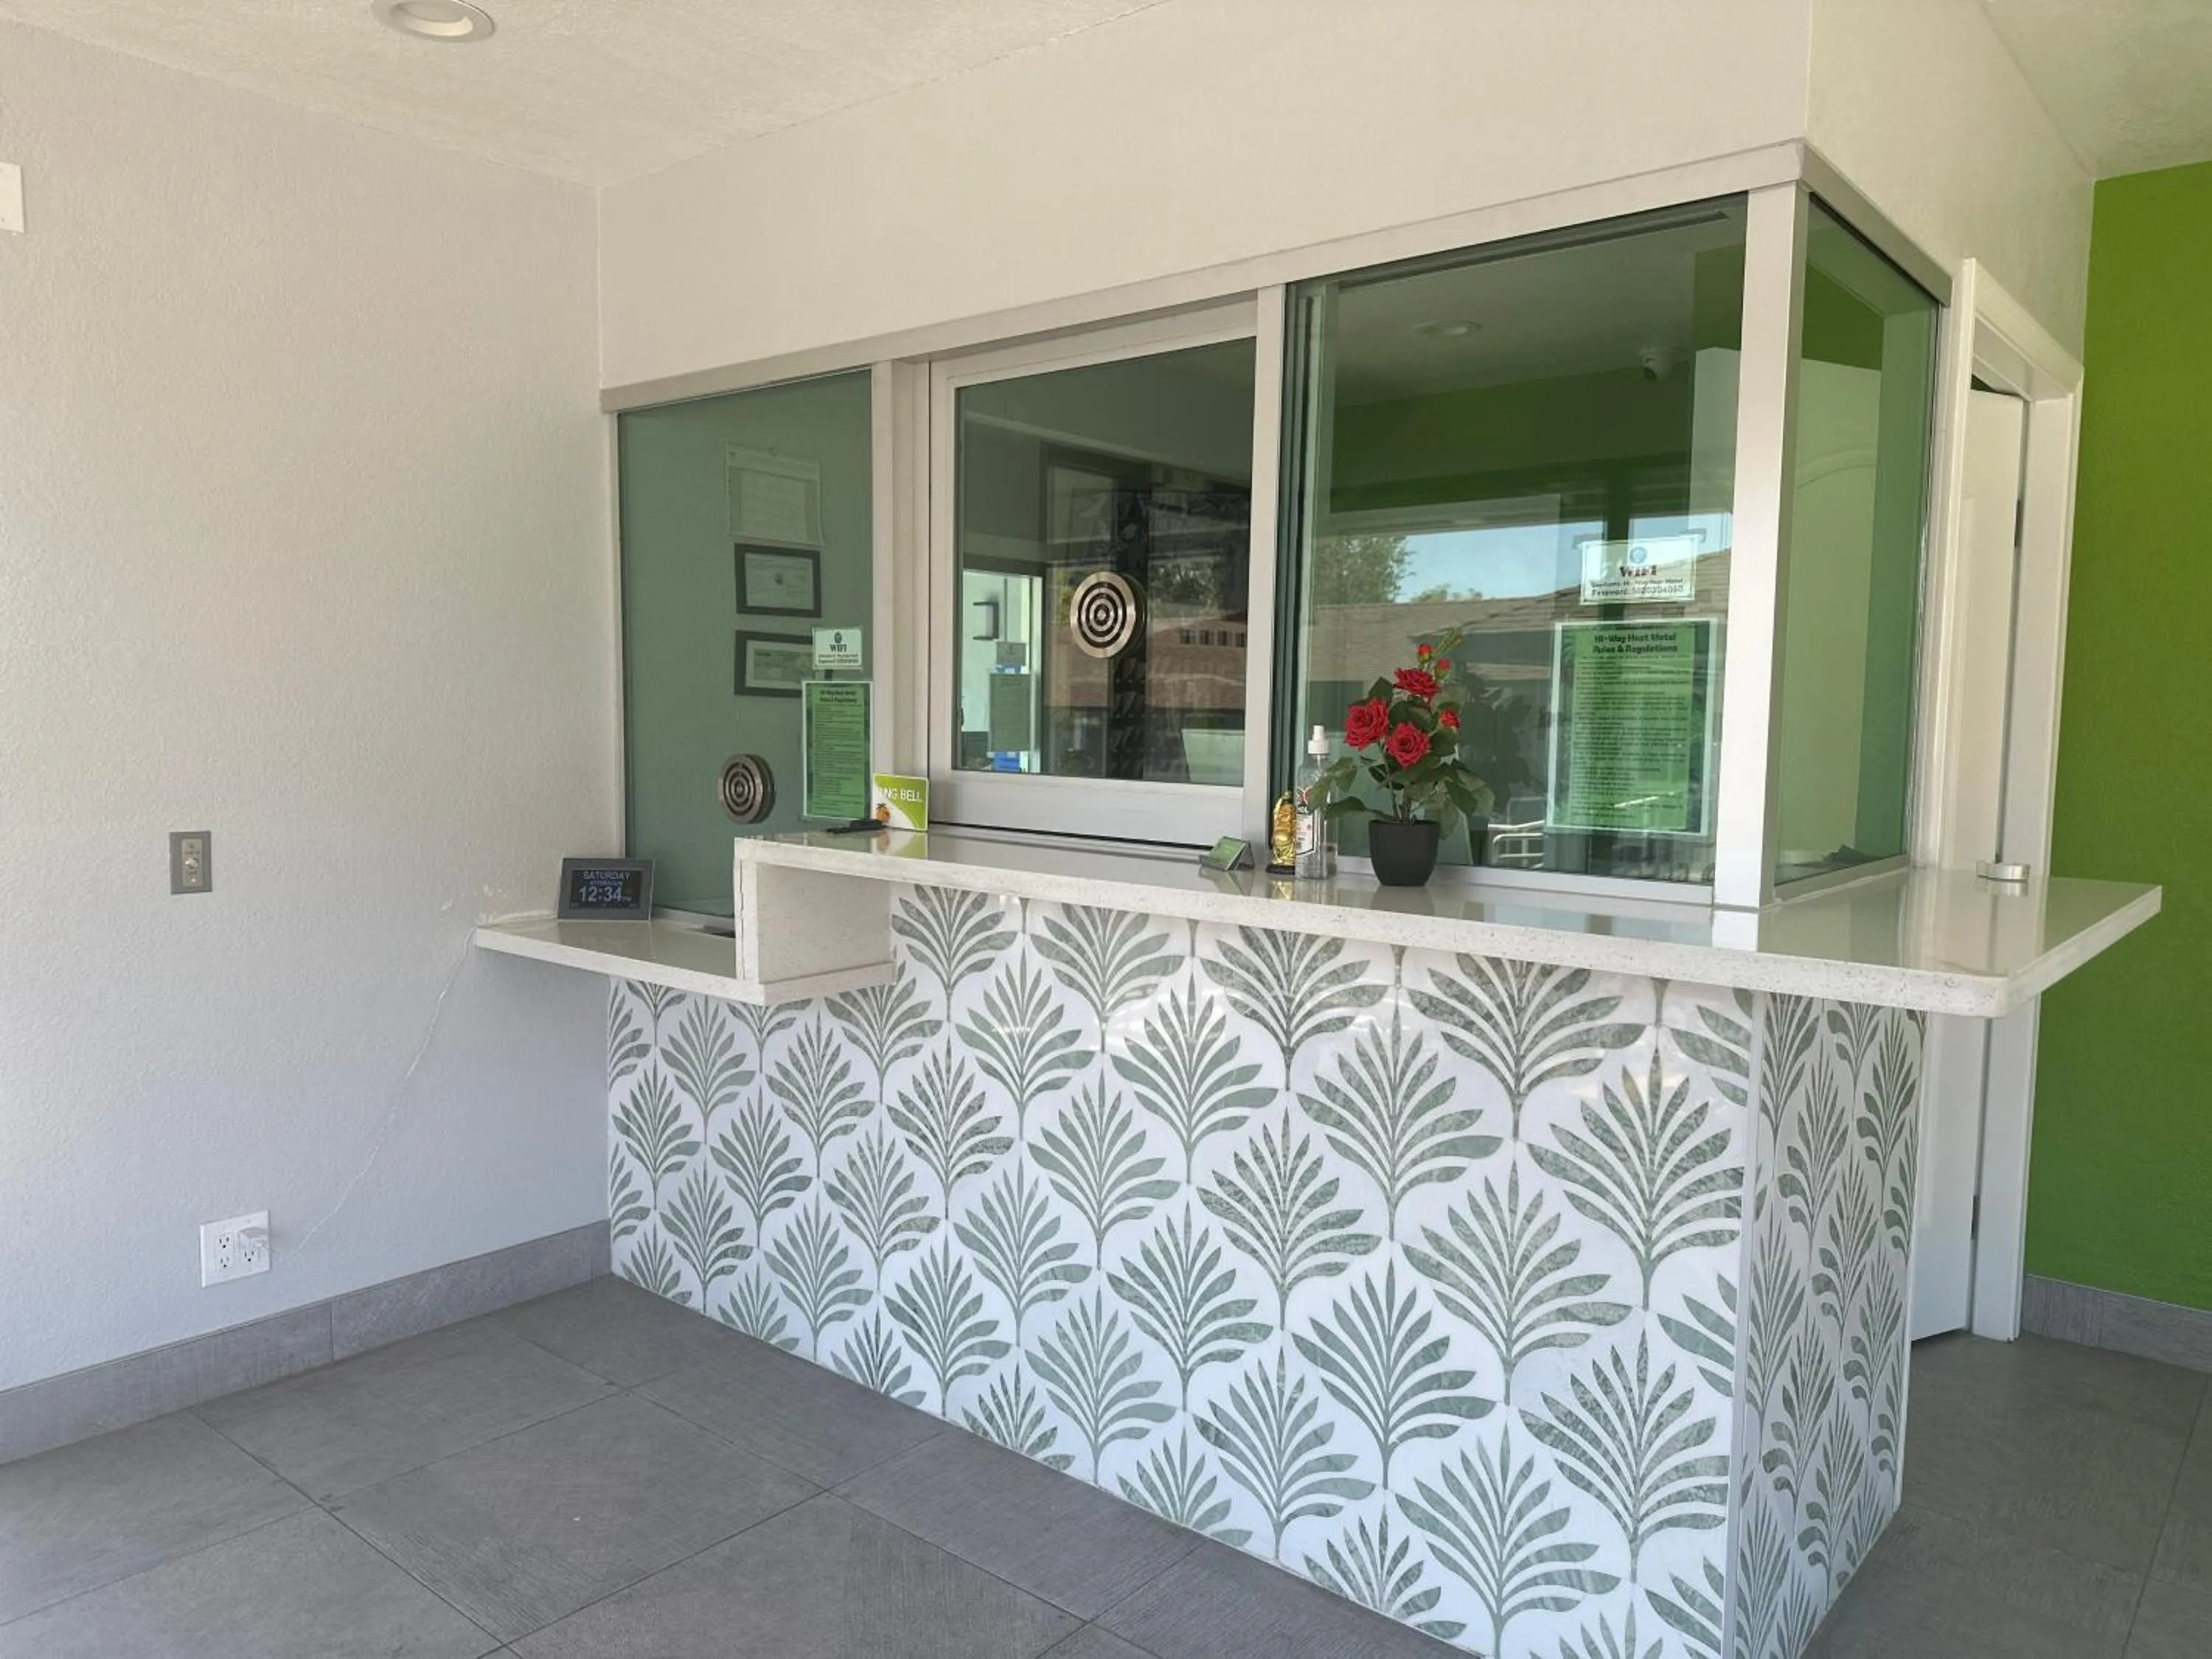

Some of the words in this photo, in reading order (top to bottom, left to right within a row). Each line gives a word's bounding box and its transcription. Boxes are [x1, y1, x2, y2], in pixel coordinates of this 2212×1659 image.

[830, 644, 847, 653] WIFI
[1625, 644, 1677, 654] Regulations
[900, 788, 923, 803] BELL
[583, 871, 630, 880] SATURDAY
[579, 886, 622, 902] 12:34
